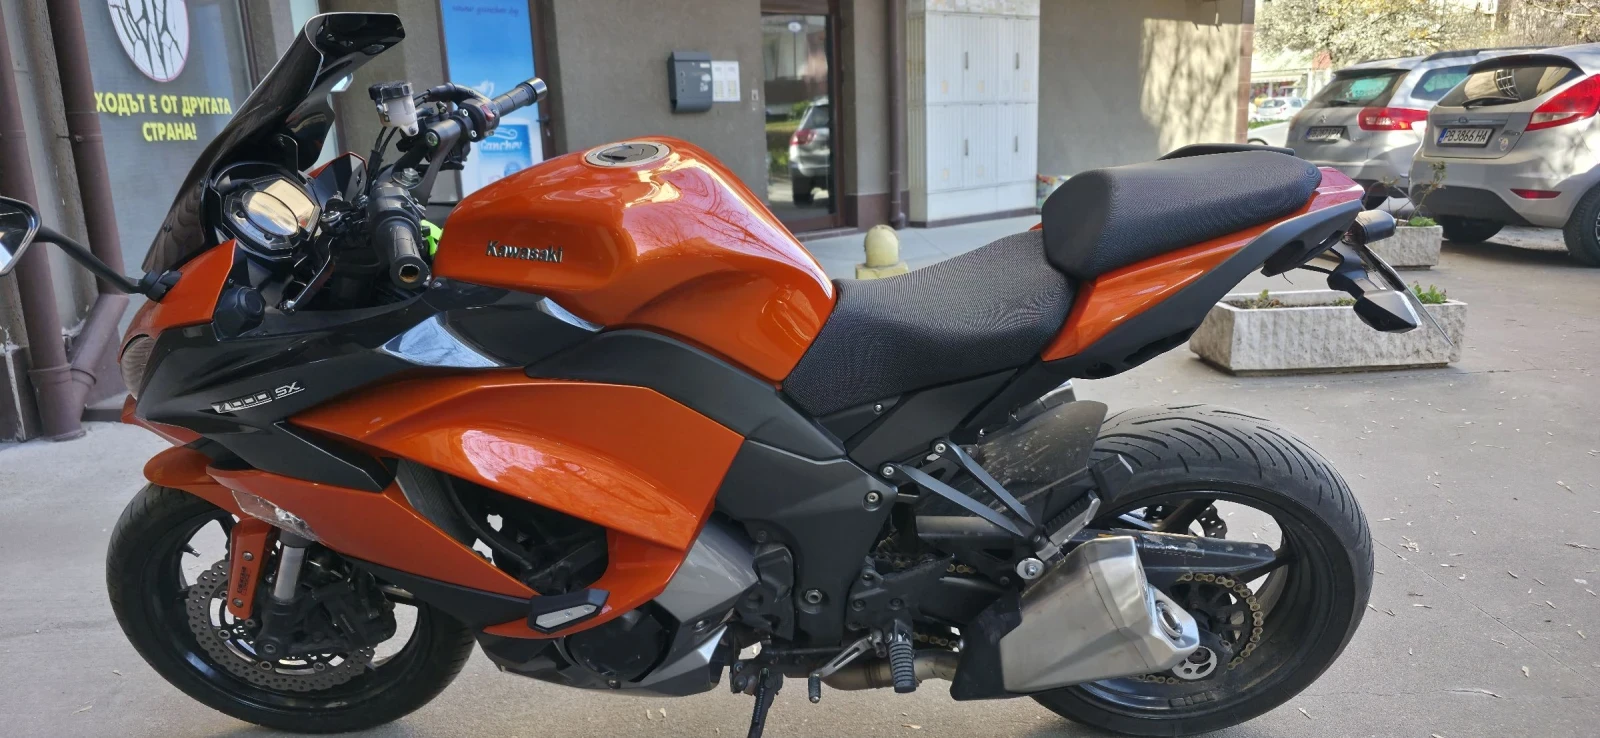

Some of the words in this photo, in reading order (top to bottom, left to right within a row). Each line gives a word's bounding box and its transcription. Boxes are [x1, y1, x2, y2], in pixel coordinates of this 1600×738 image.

[149, 94, 158, 113] Е
[161, 94, 178, 114] ОТ
[181, 96, 232, 117] ДРУГАТА
[142, 121, 197, 142] СТРАНА!
[485, 240, 563, 263] Kawasaki
[275, 381, 303, 397] SX
